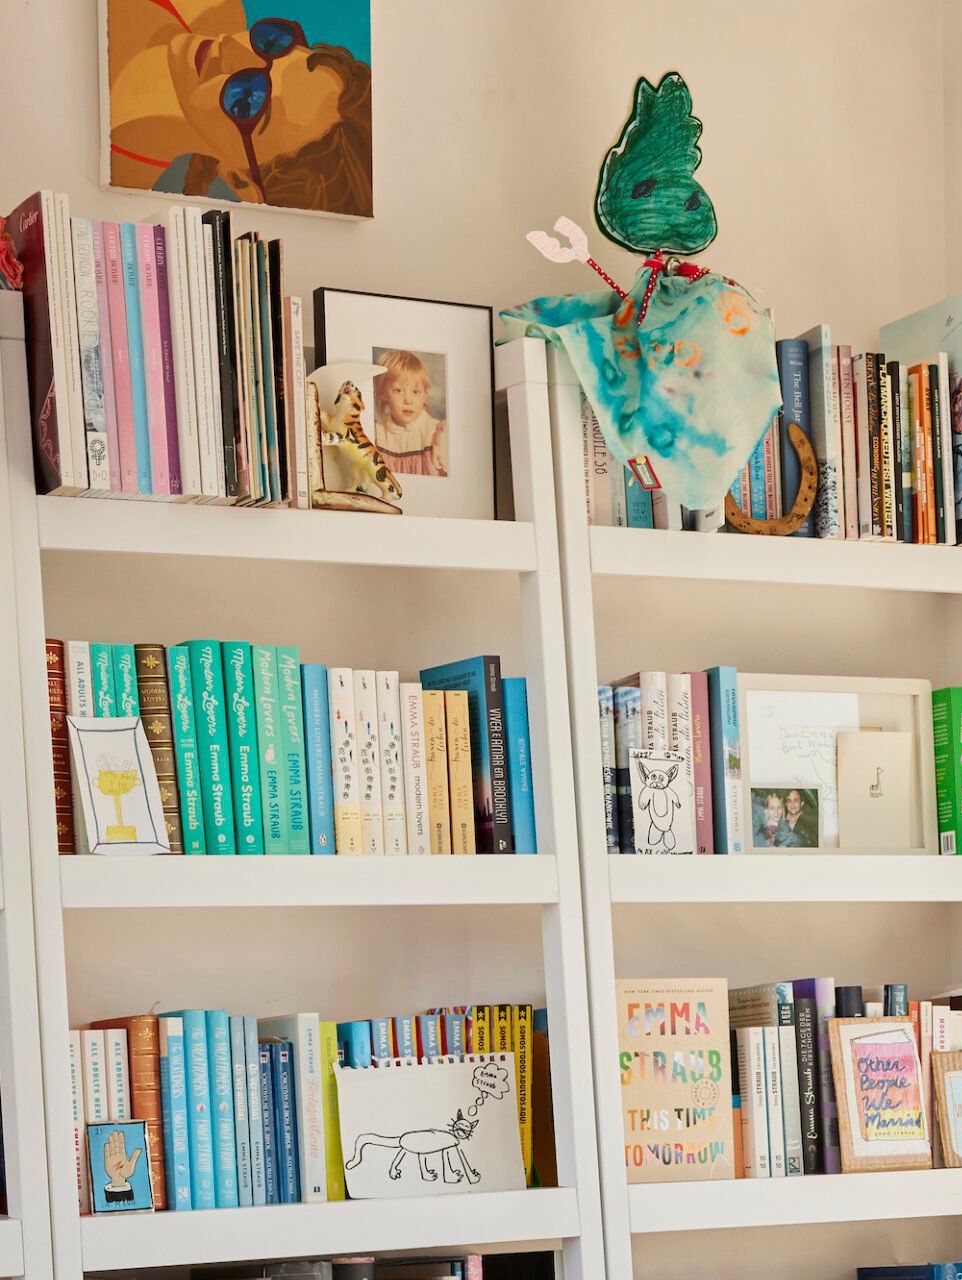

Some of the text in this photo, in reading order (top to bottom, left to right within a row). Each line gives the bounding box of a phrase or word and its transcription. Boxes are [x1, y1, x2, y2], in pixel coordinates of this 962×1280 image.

[19, 210, 39, 234] Cartier
[77, 225, 93, 277] TAVI GEVINSON
[80, 290, 97, 339] ROOKIE
[792, 371, 804, 422] The Bell Jar
[885, 489, 893, 525] WINTER
[78, 679, 86, 708] ADULTS
[489, 708, 502, 732] VIVER
[671, 712, 679, 740] STRAUB
[200, 647, 225, 827] Modern Lovers Emma Straub
[230, 648, 255, 827] Modern Lovers Emma Straub
[258, 650, 281, 839] Modern Lovers EMMA STRAUB
[280, 655, 304, 831] Modern Lovers EMMA STRAUB
[408, 695, 424, 836] EMMA STRAUB modern lovers
[491, 739, 504, 765] AMAR
[517, 738, 529, 792] EMMA STRAUB
[494, 780, 507, 824] BROOKLYN
[452, 1021, 461, 1047] EMMA
[627, 1002, 710, 1037] EMMA
[379, 1022, 388, 1049] EMMA
[192, 1041, 207, 1097] VACATIONERS
[619, 1049, 722, 1085] STRAUB
[857, 1053, 905, 1073] Other
[859, 1073, 911, 1094] People
[117, 1097, 125, 1120] HERE
[804, 1068, 818, 1140] Emma Straub
[862, 1094, 902, 1111] We
[197, 1119, 209, 1141] EMMA
[627, 1107, 718, 1131] THIS TIME
[864, 1110, 922, 1129] Married
[198, 1144, 210, 1172] STRAUB
[624, 1141, 725, 1167] TOMORROW
